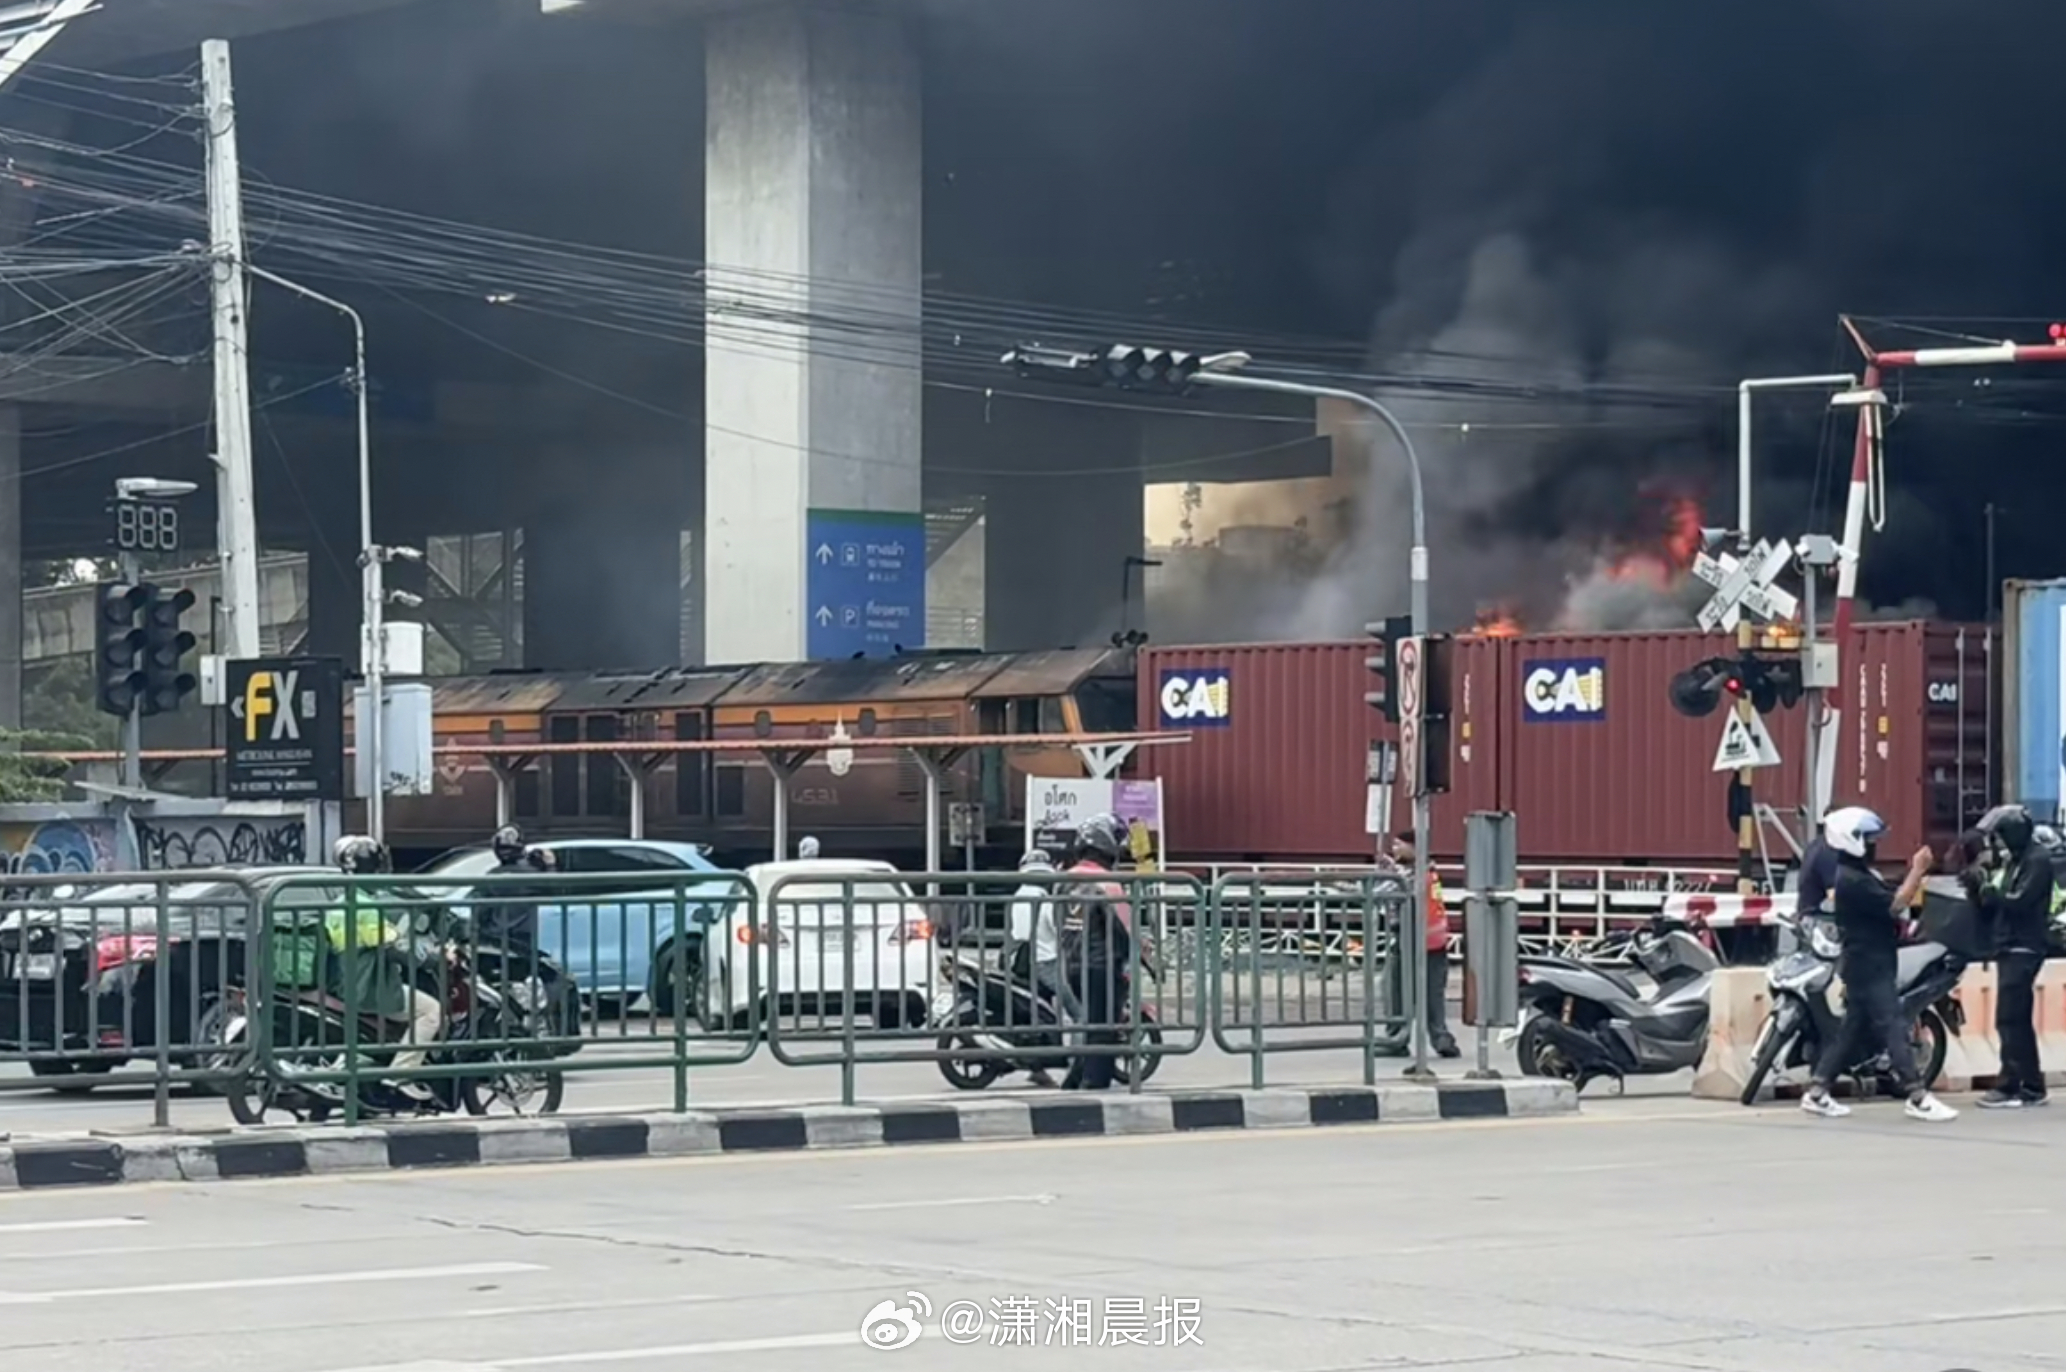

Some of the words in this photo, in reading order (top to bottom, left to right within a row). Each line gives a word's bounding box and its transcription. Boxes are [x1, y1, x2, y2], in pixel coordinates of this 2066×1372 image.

[1161, 676, 1229, 719] CAI
[1525, 666, 1603, 714] CAI
[1928, 682, 1957, 701] CAI
